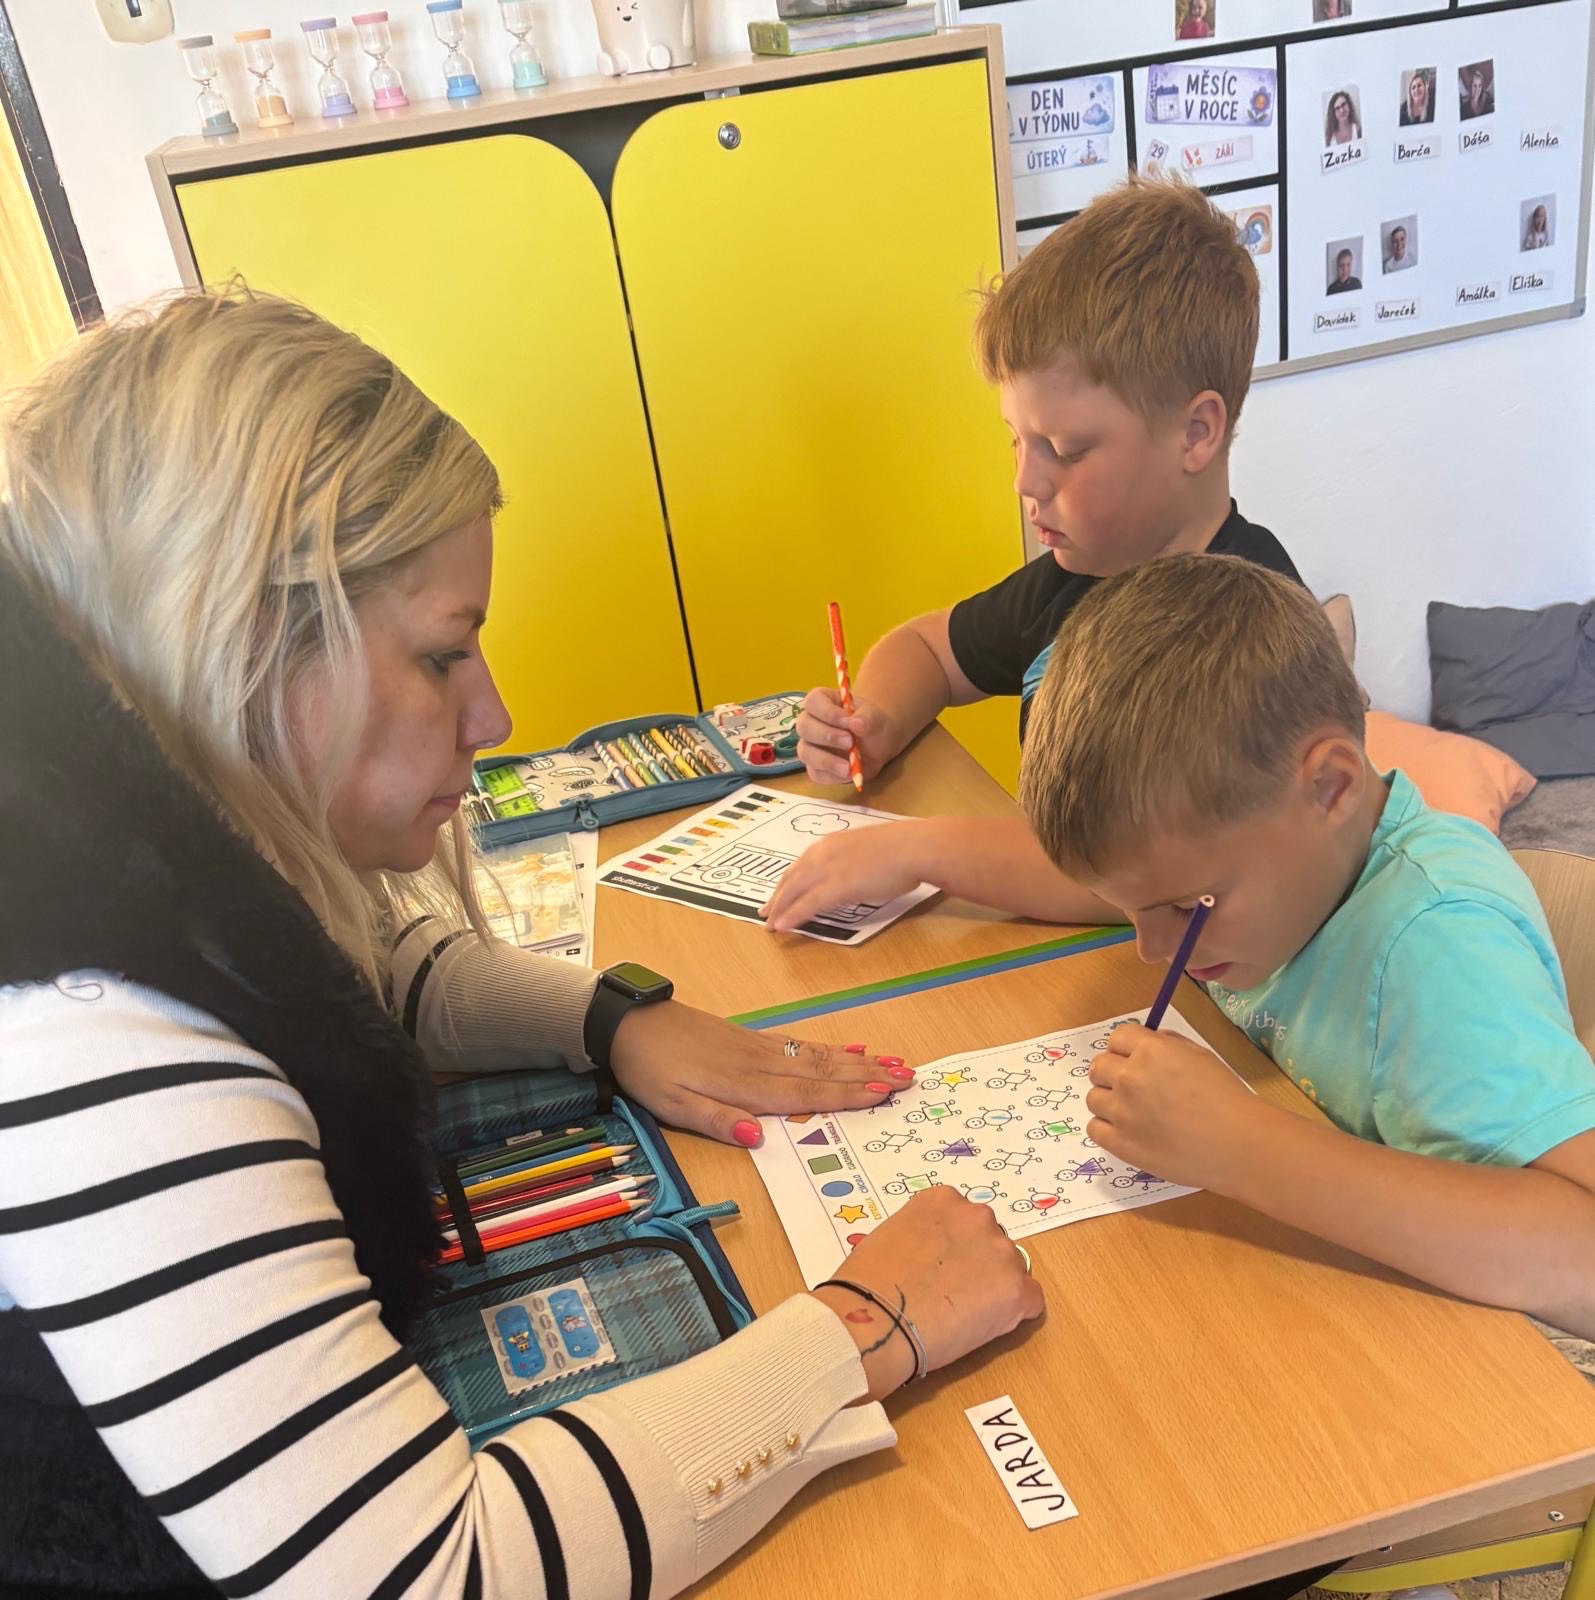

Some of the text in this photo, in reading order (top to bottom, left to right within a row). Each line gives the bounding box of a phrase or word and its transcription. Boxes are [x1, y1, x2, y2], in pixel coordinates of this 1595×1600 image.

[1186, 69, 1237, 96] MĚSÍC
[1031, 88, 1064, 111] DEN
[1185, 99, 1239, 121] V ROCE
[1018, 110, 1080, 136] V TÝDNU
[1463, 131, 1491, 149] Dáša
[1522, 131, 1560, 149] Alenka
[1026, 148, 1068, 170] ÚTERÝ
[1151, 144, 1165, 160] 29
[1215, 143, 1235, 160] ZÁŘÍ
[1324, 144, 1362, 169] Zuzka
[1512, 275, 1544, 291] Eliška
[1458, 287, 1496, 302] Amálka
[1316, 312, 1357, 329] Davídek
[982, 1407, 1066, 1511] JARDA
